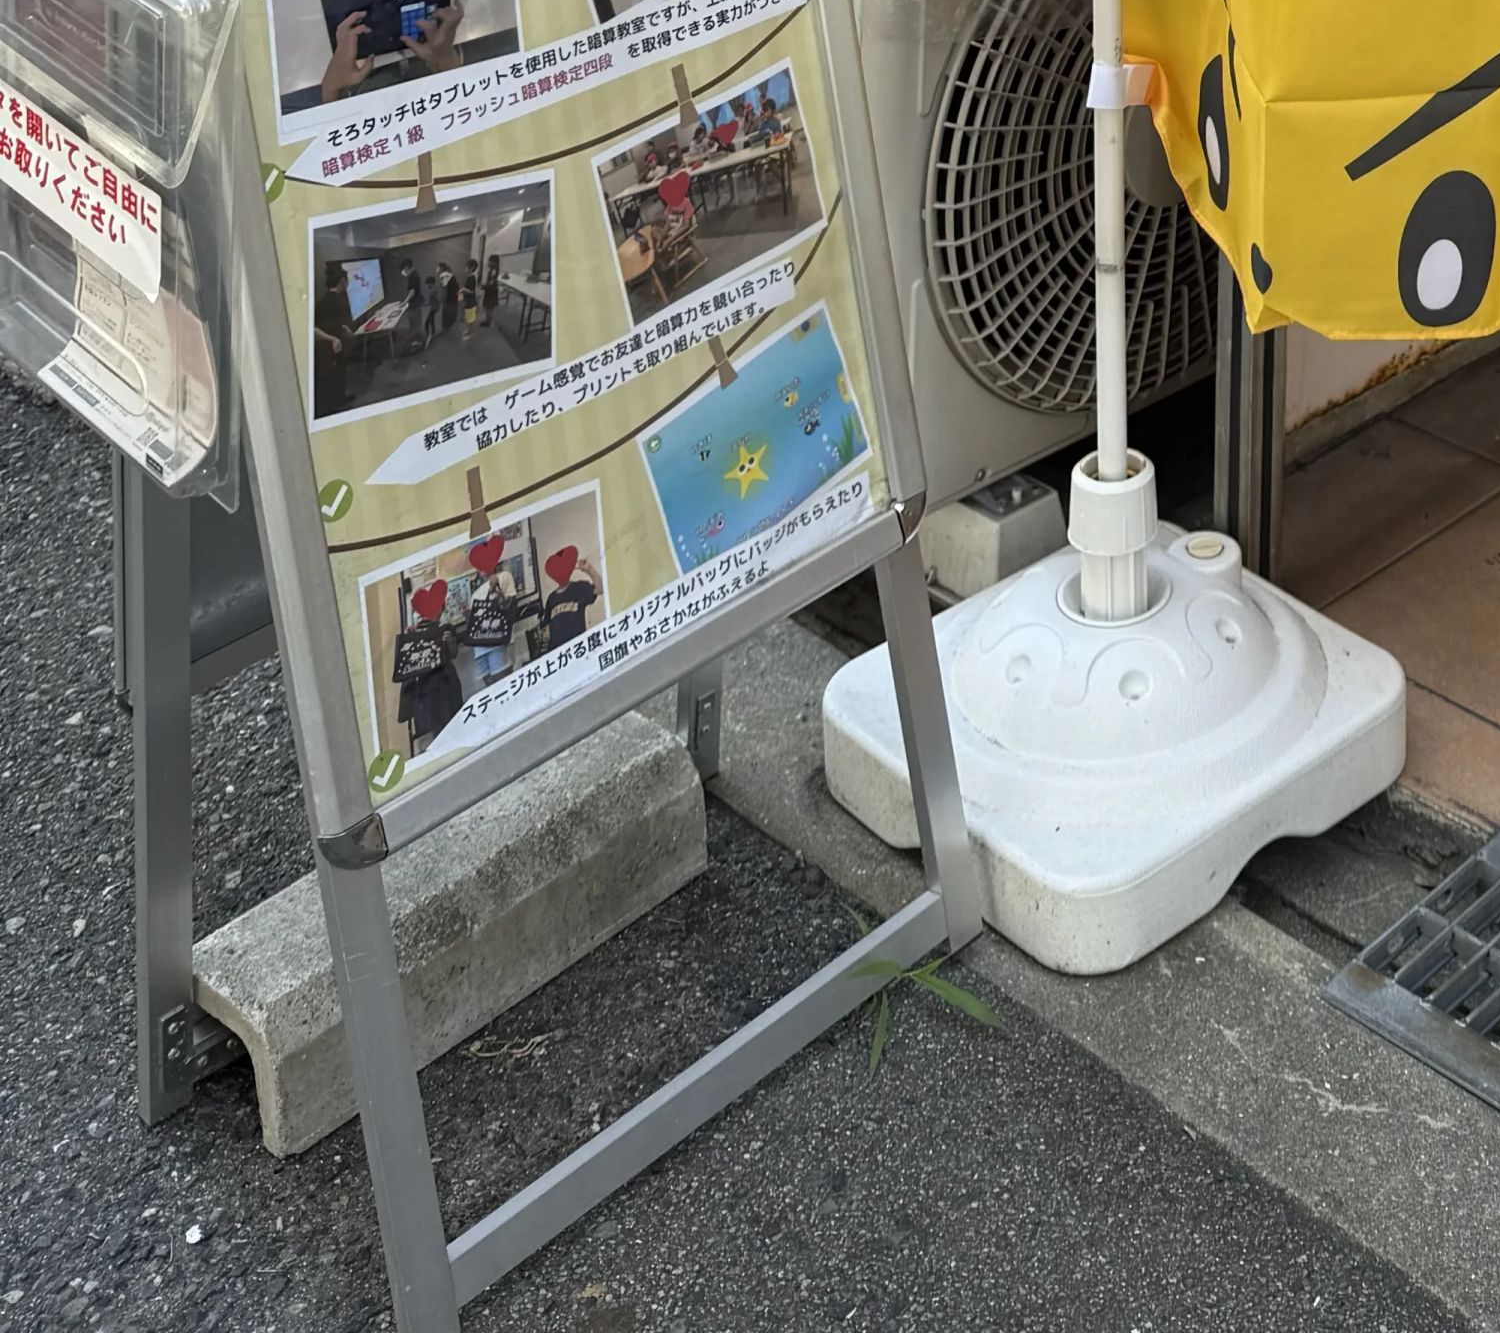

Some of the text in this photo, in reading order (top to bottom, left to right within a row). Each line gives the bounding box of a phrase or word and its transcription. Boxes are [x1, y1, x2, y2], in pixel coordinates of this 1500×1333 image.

[440, 52, 614, 131] フラッシュ暗算検定四段
[423, 260, 796, 452] 教室では ゲーム感覚でお友達と暗算力を競い合ったり
[461, 480, 863, 725] ステージが上がる度にオリジナルバッグにバッジがもらえたり
[598, 562, 770, 672] 国旗やおさかながふえるよ
